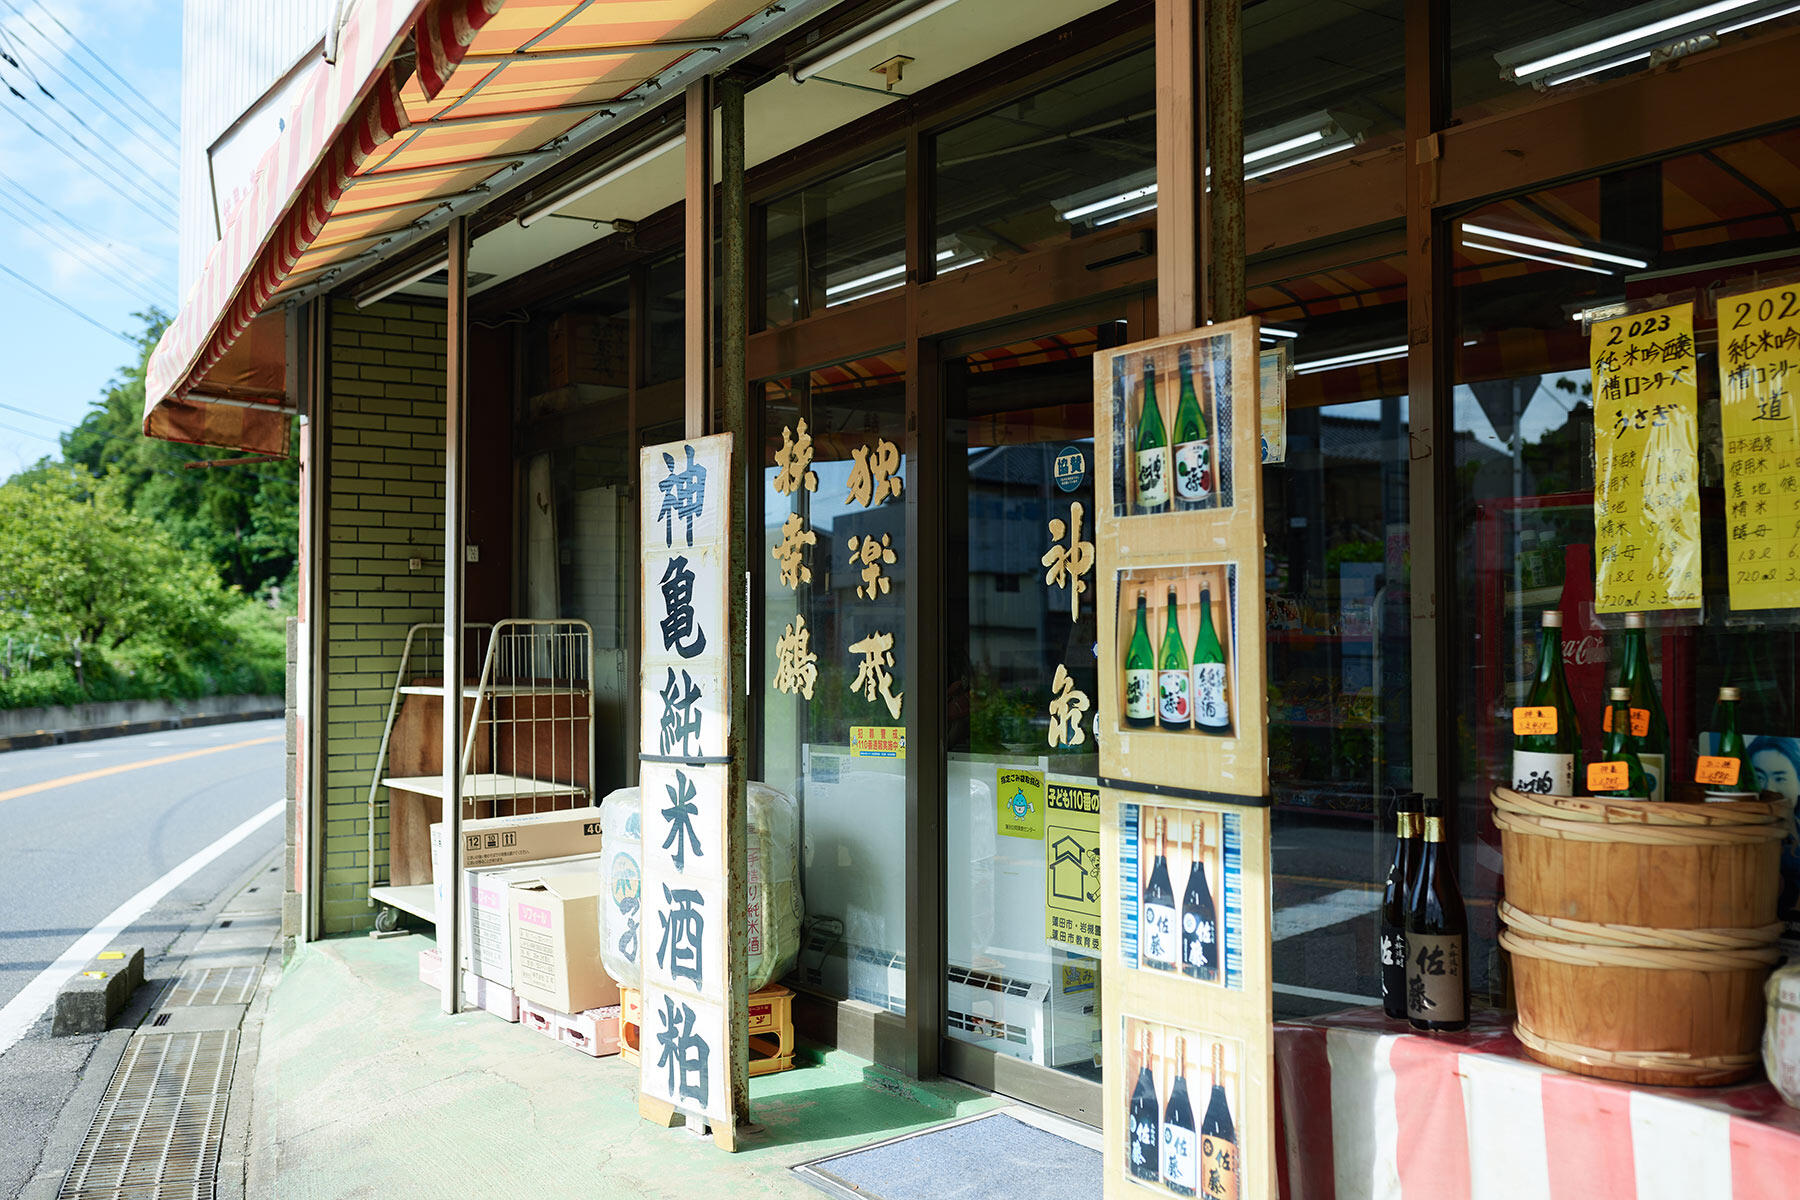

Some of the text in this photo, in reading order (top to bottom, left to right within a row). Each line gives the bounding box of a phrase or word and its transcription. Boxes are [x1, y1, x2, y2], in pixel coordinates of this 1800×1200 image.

[1606, 315, 1671, 346] 2023
[1728, 326, 1800, 364] 純米吟
[1595, 333, 1695, 375] 純米吟醸
[1614, 403, 1678, 439] うさぎ
[1752, 387, 1791, 421] 道
[1057, 455, 1082, 475] 協賛
[655, 444, 710, 1109] 神亀純米酒粕
[1048, 788, 1100, 812] 子ども110番の
[469, 837, 479, 847] 12
[1409, 945, 1446, 1013] 佐藤
